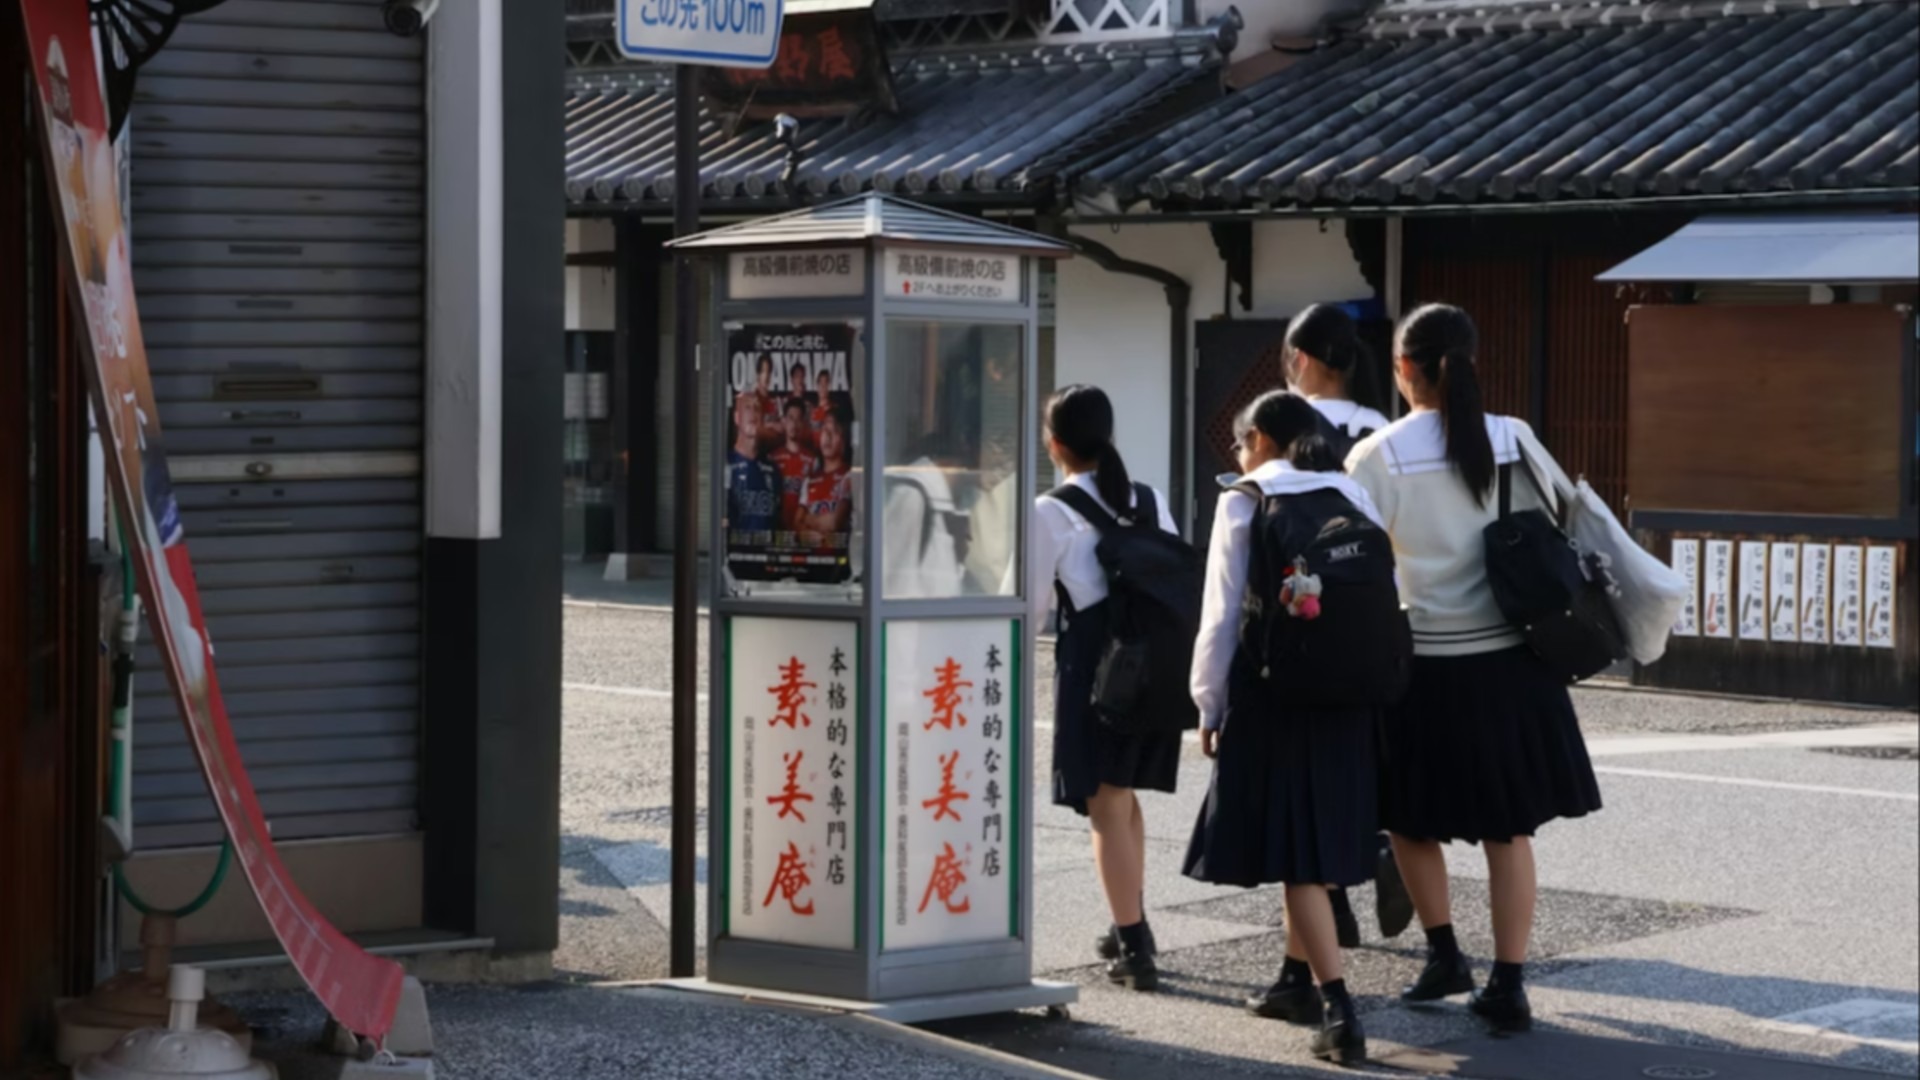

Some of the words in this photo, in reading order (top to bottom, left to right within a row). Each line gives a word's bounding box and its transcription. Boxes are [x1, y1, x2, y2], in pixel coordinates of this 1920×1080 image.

[641, 0, 765, 34] この先100m
[743, 254, 851, 277] 高級備前焼の店
[897, 254, 1006, 280] 高級備前焼の店
[762, 655, 817, 917] 素美庵
[826, 646, 848, 886] 本格的な専門店
[917, 656, 974, 915] 素美庵
[981, 643, 1003, 878] 本格的な専門店
